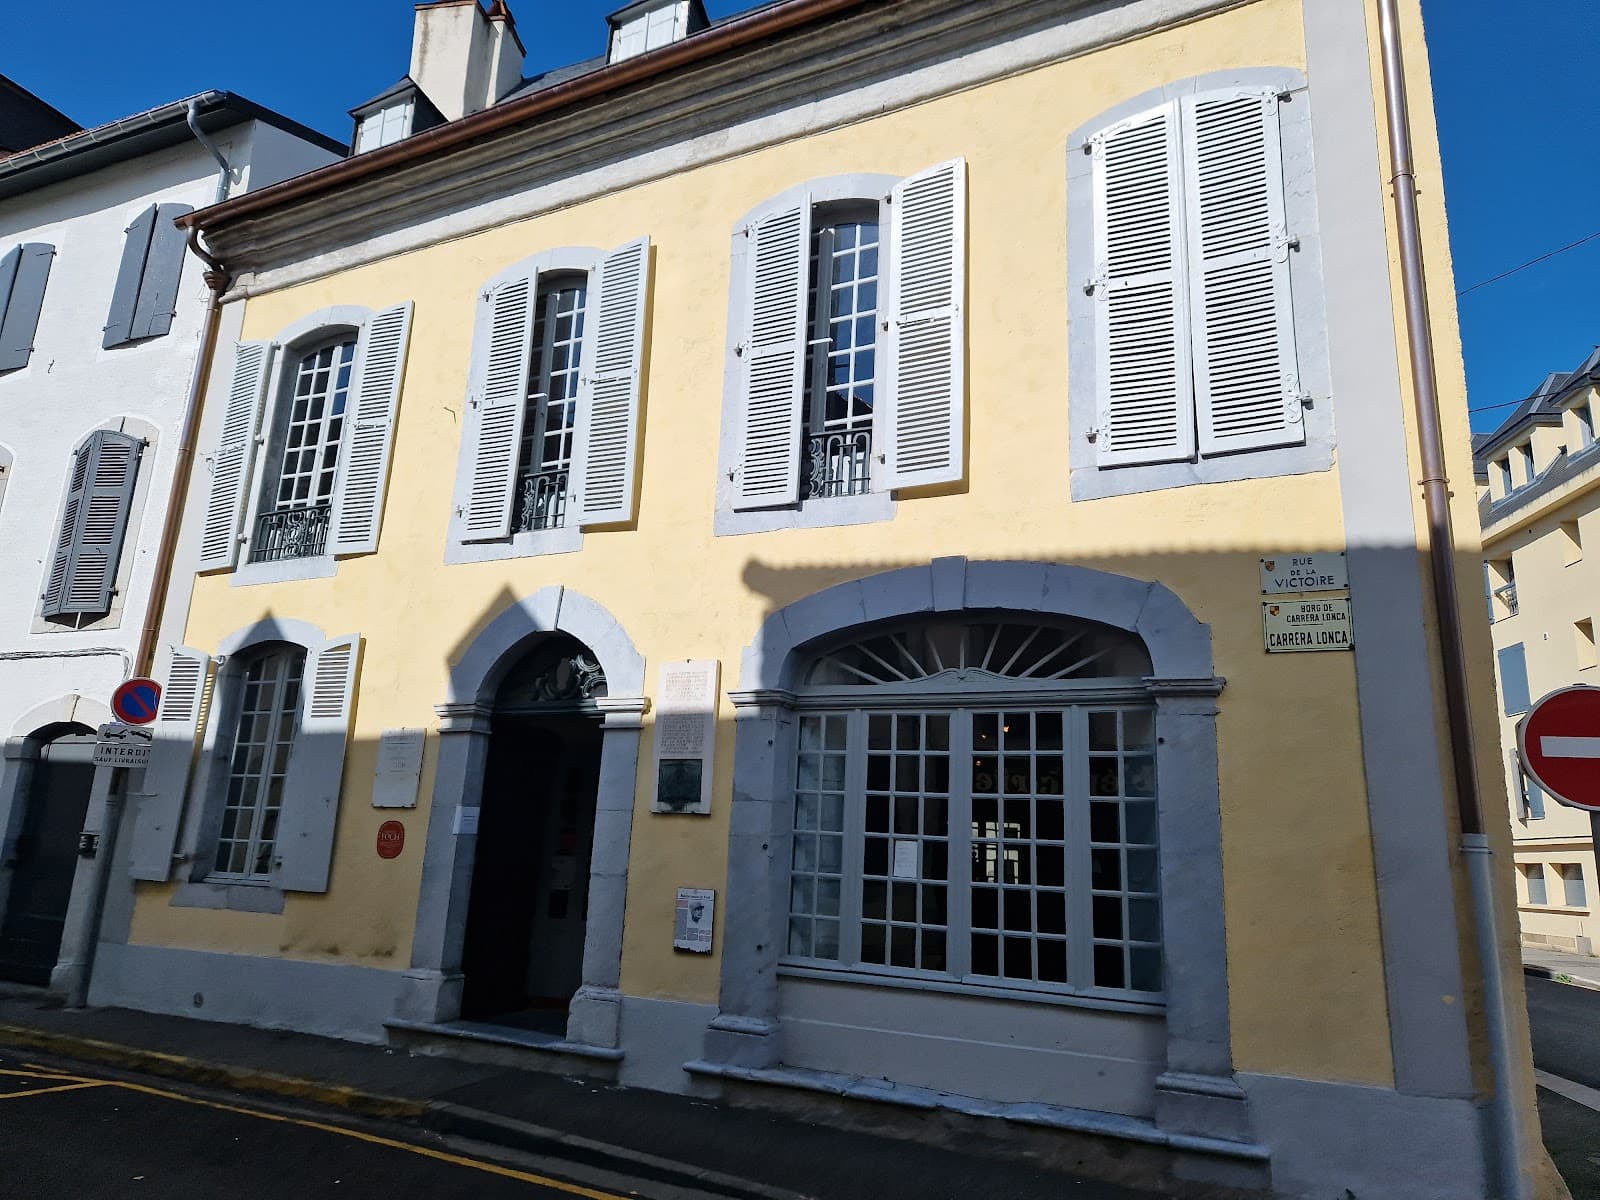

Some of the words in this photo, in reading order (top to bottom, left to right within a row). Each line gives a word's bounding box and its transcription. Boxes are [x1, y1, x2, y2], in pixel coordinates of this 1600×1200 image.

[1292, 557, 1313, 566] RUE
[1275, 575, 1335, 588] VICTOIRE
[1301, 604, 1321, 613] BORG
[1323, 603, 1333, 612] DE
[1316, 630, 1348, 645] LONCA
